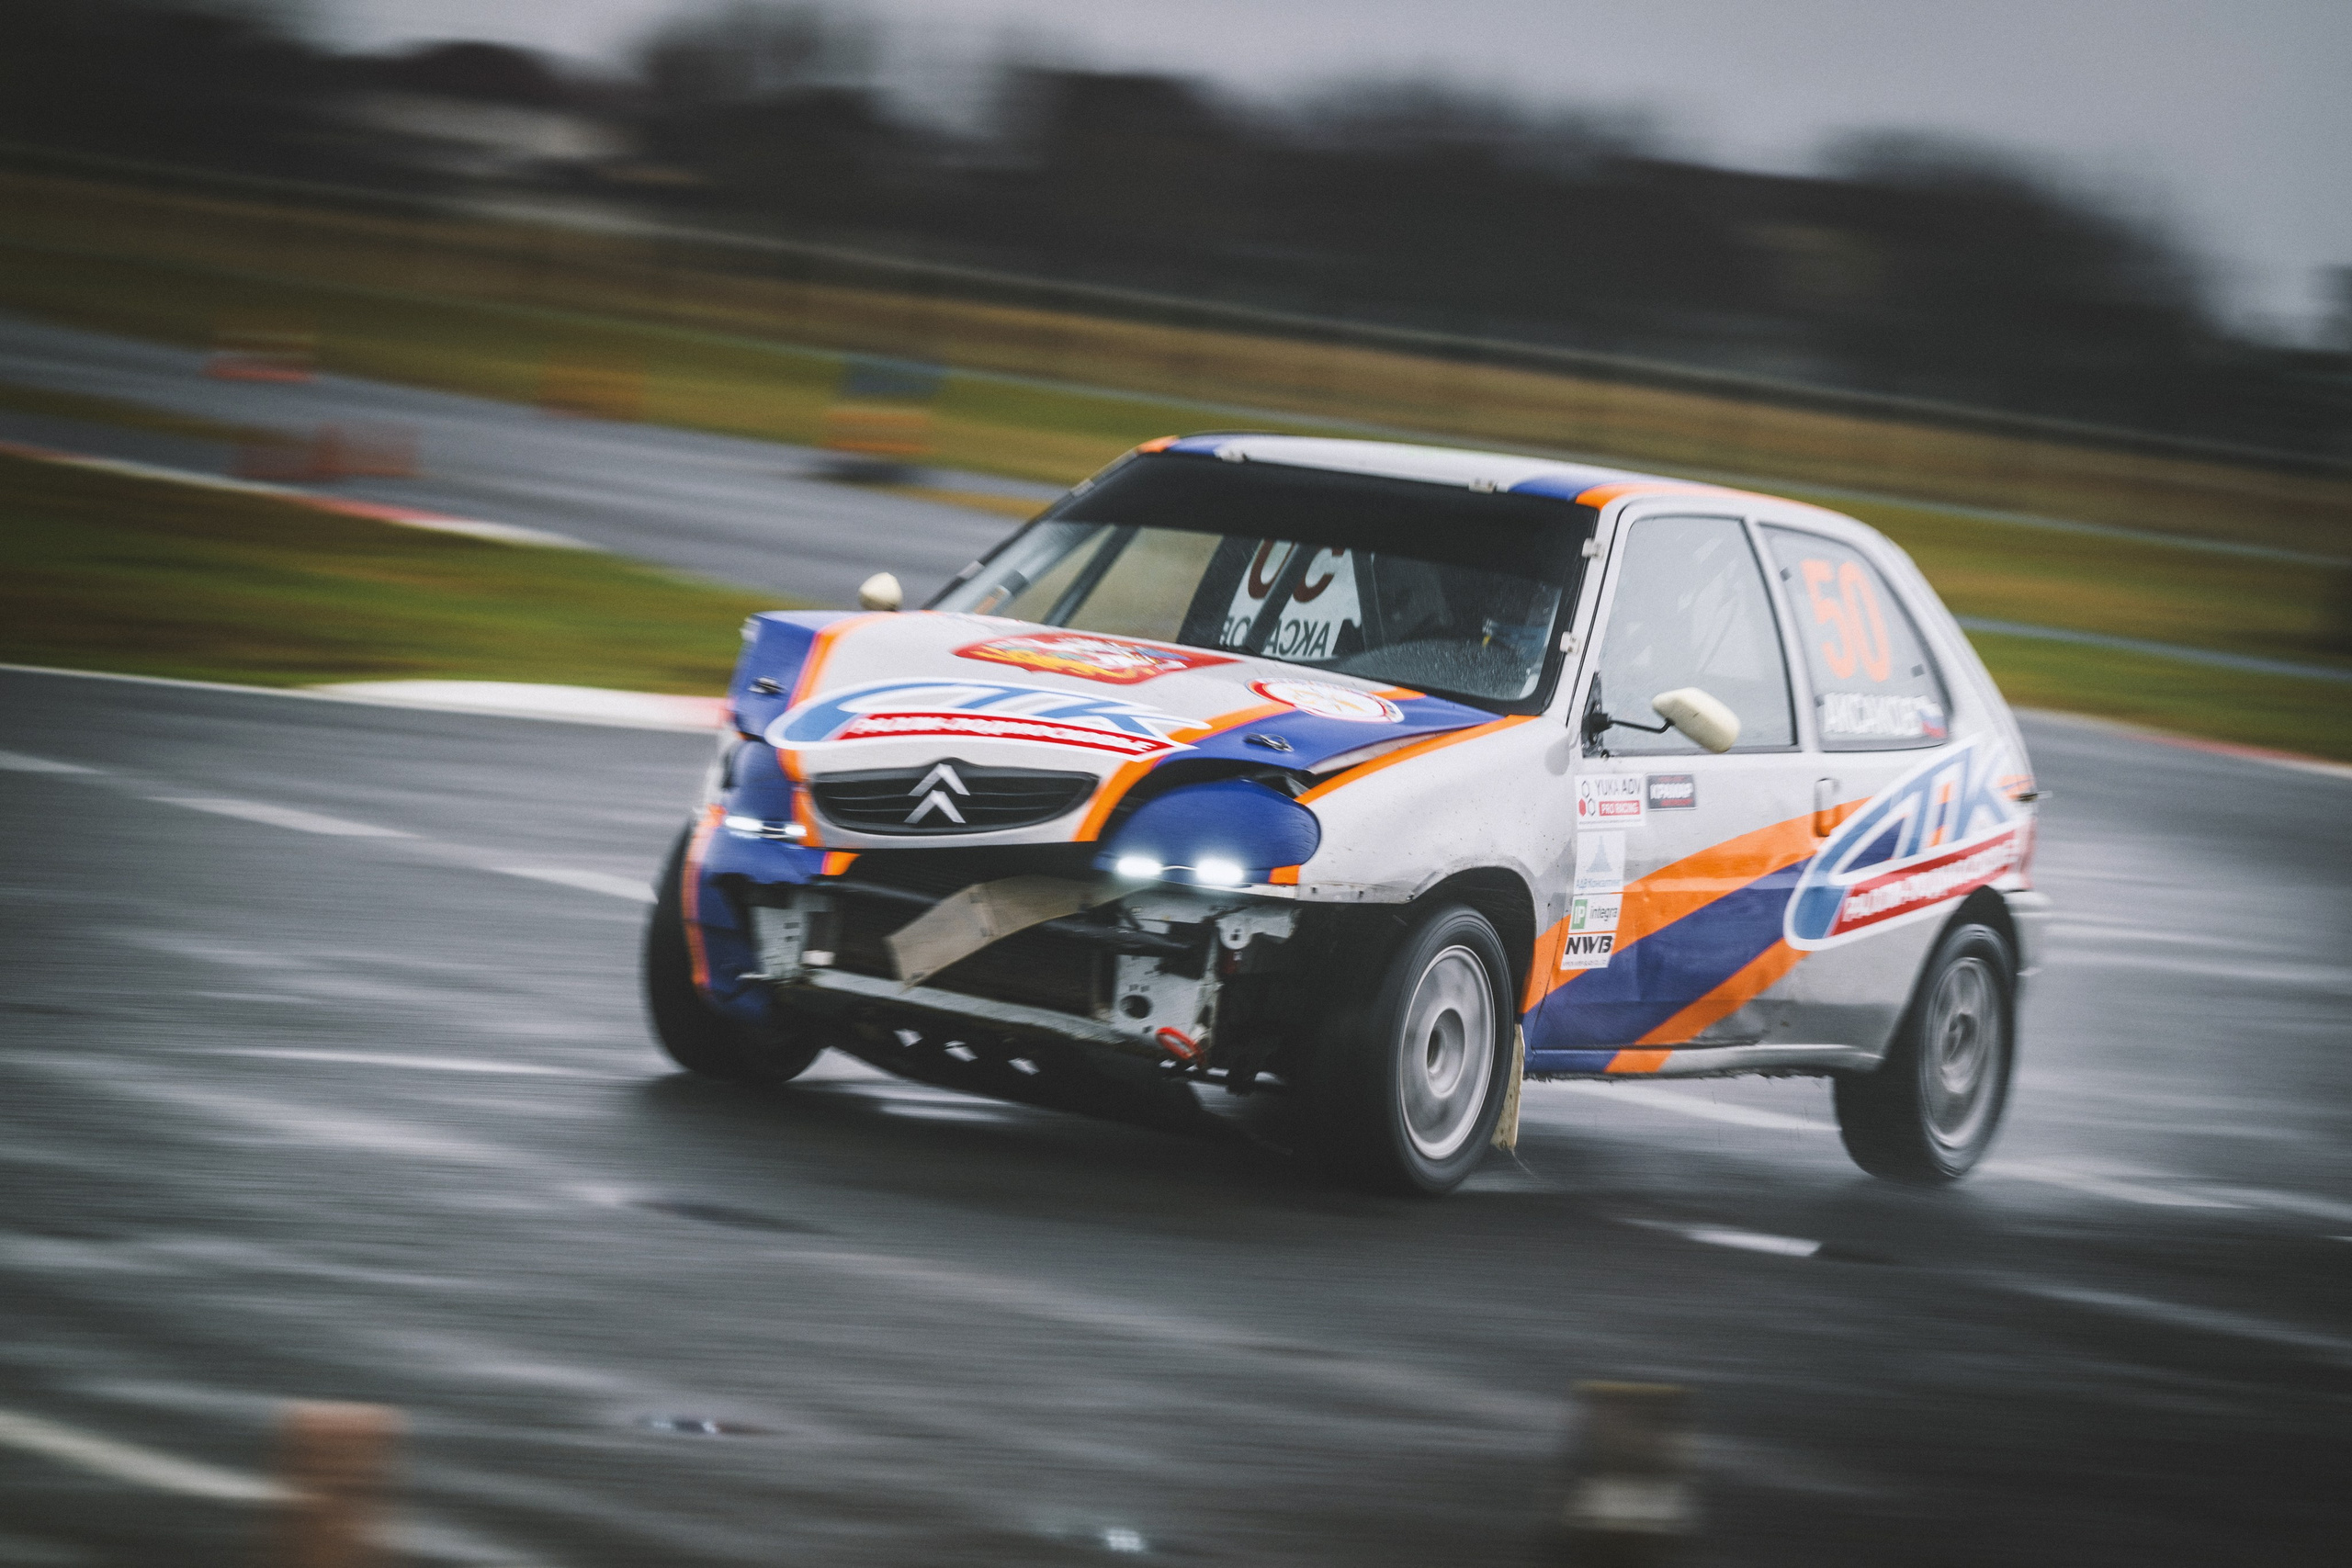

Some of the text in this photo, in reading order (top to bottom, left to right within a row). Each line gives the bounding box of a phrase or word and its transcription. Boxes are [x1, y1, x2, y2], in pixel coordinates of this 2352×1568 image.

[1800, 558, 1891, 683] 50
[1600, 802, 1639, 815] PRO RACING
[1589, 906, 1618, 921] integra
[1565, 935, 1612, 955] NWB
